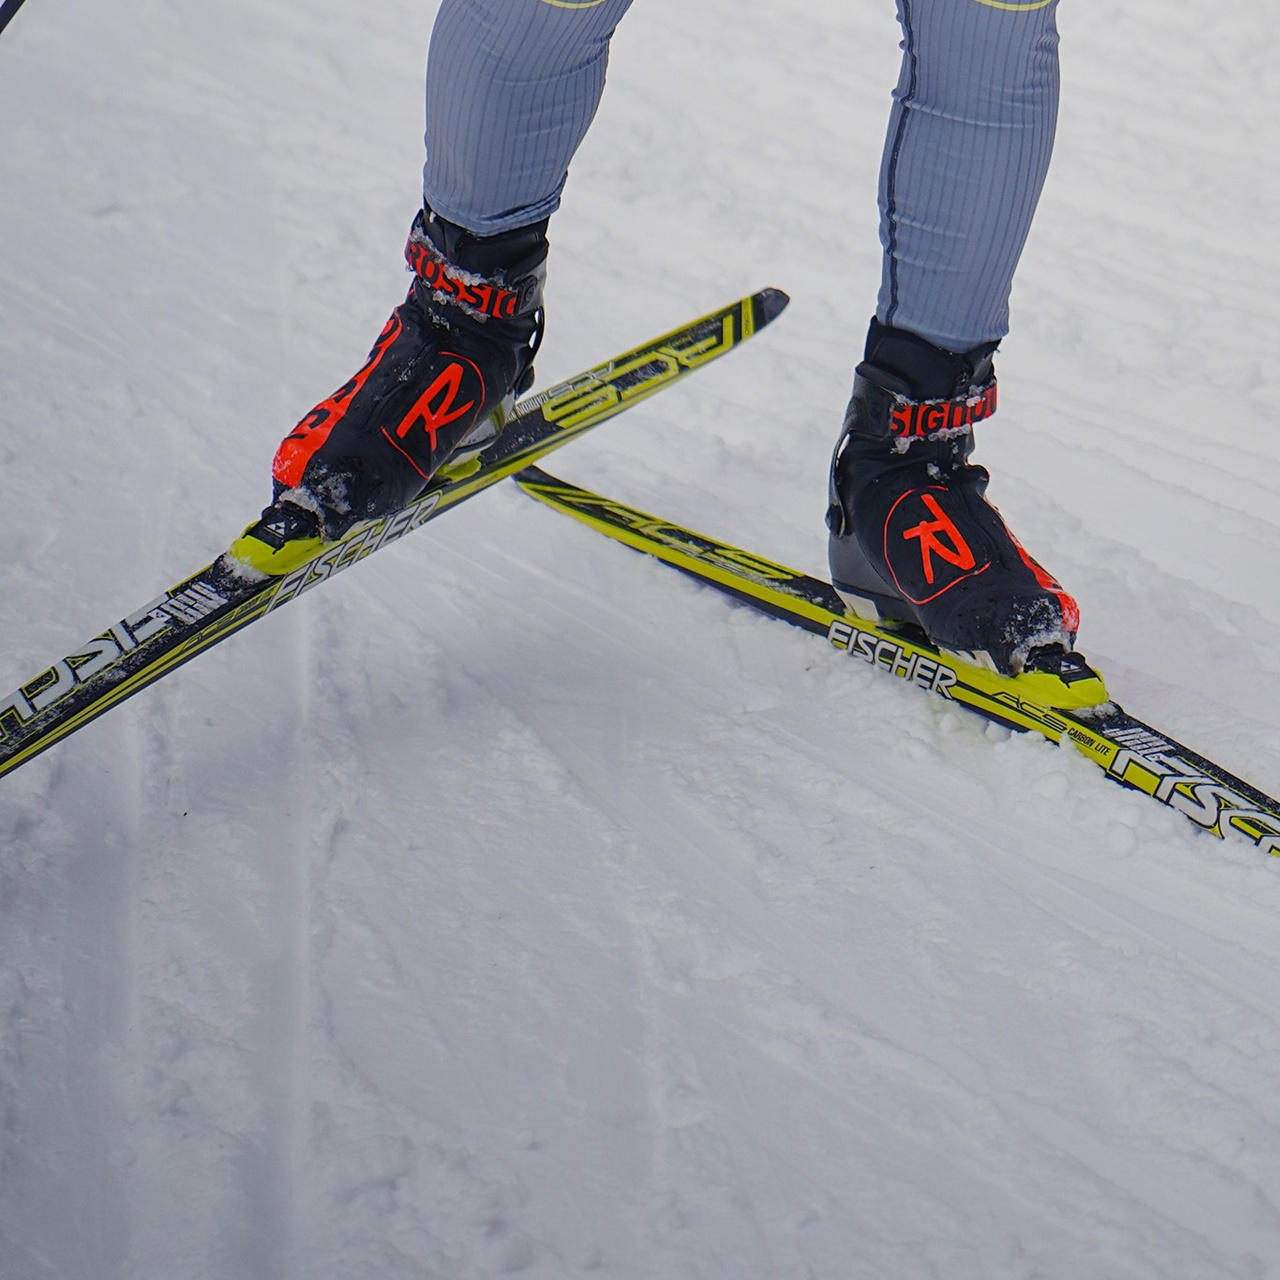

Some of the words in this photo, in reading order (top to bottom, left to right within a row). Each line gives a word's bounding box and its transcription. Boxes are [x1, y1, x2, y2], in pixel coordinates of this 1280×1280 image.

[827, 620, 958, 700] FISCHER
[1066, 726, 1095, 749] CARBON
[1094, 741, 1112, 758] LITE
